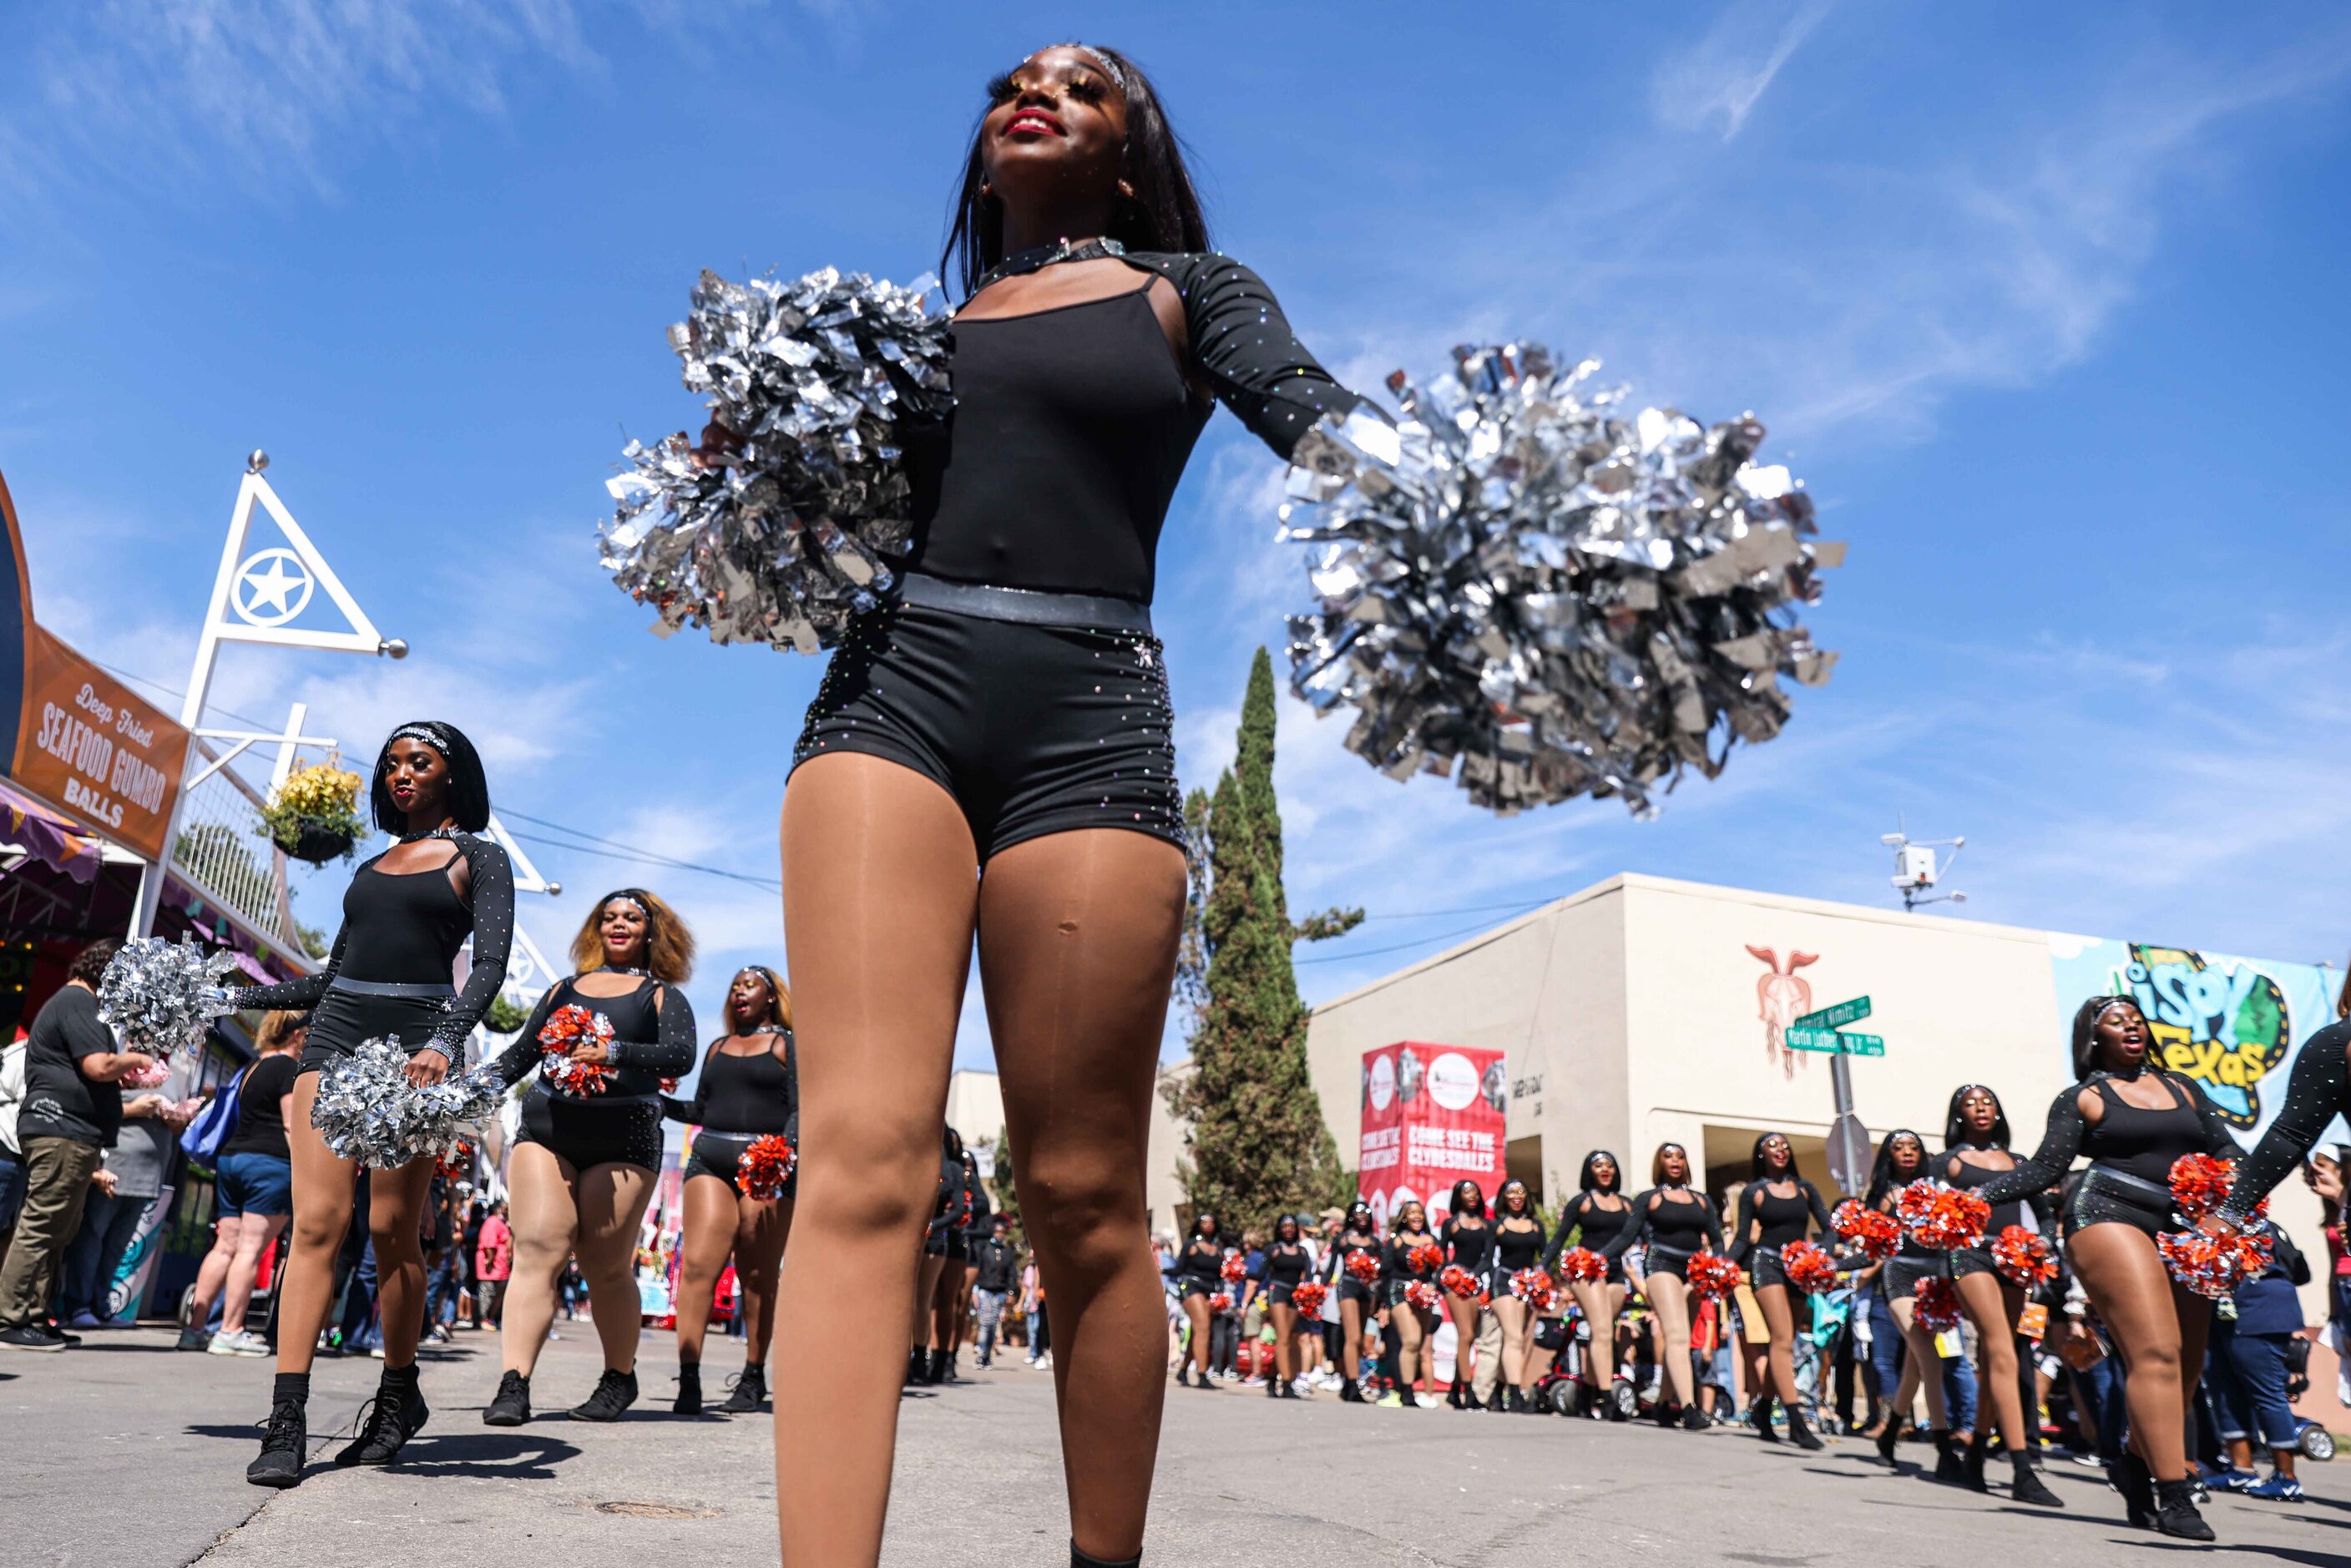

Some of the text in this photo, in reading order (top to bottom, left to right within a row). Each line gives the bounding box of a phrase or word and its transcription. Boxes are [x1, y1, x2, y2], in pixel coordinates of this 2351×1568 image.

[75, 683, 154, 748] Deep Fried
[38, 701, 166, 815] SEAFOOD GUMBO
[64, 776, 124, 828] BALLS
[1827, 1004, 1854, 1025] Nimitz
[1787, 1028, 1811, 1046] Martin
[1408, 1125, 1494, 1152] COME SEE THE
[1408, 1145, 1495, 1172] CLYDESDALES
